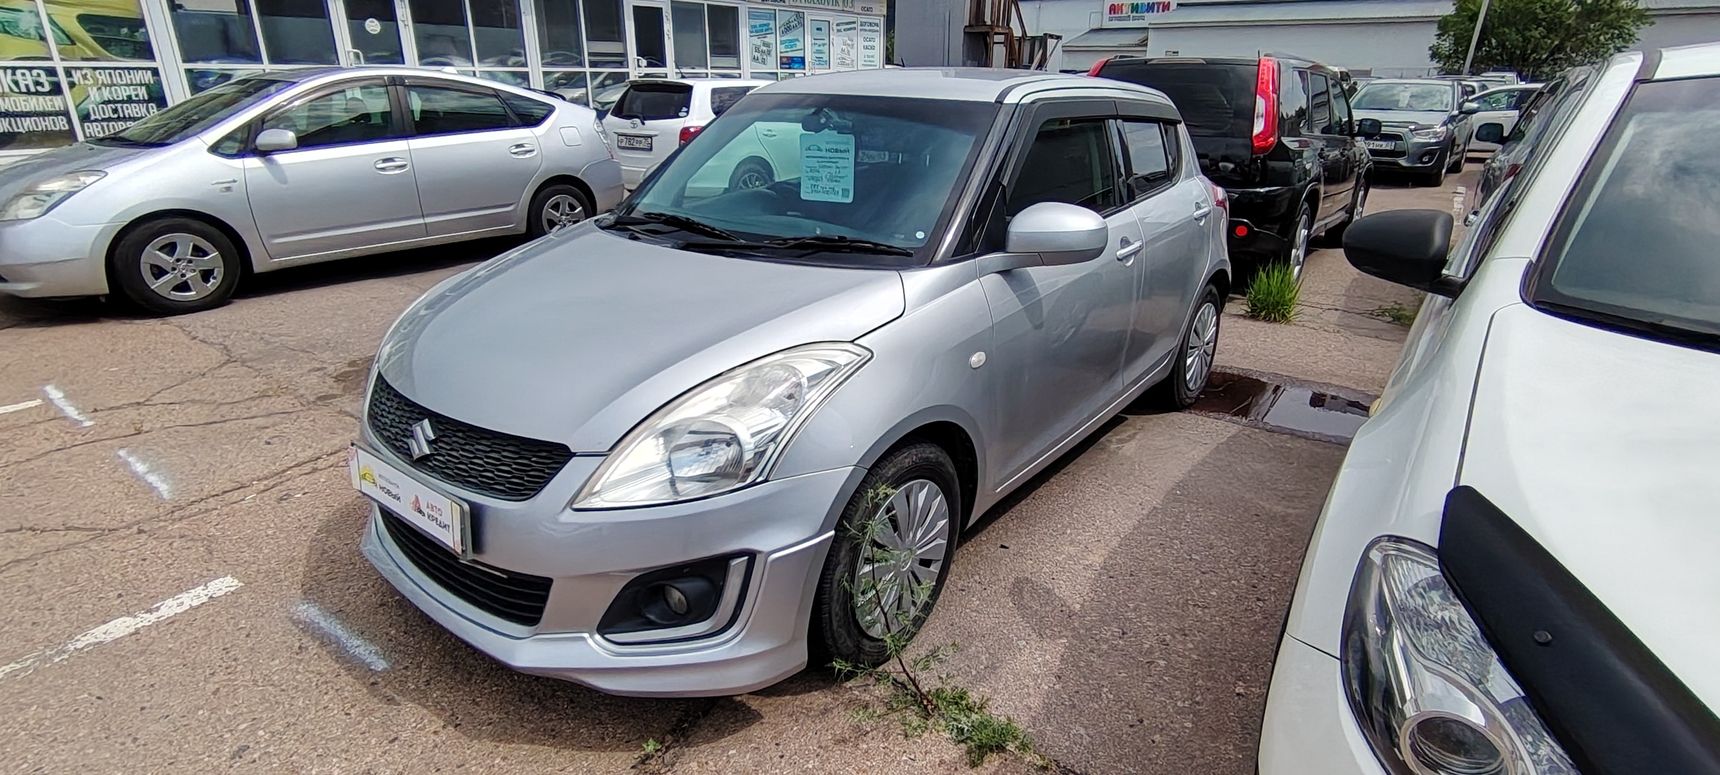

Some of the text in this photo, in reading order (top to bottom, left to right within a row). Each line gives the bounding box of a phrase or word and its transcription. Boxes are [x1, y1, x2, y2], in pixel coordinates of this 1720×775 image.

[1108, 1, 1171, 15] АКТИВИТИ
[71, 69, 154, 85] ИЗ ЯПОНИИ
[88, 85, 149, 101] И КОРЕИ
[89, 103, 158, 120] ДОСТАВКА
[379, 483, 402, 503] НОВЫЙ
[426, 501, 444, 517] АВТО
[427, 513, 451, 534] КРЕДИТ
